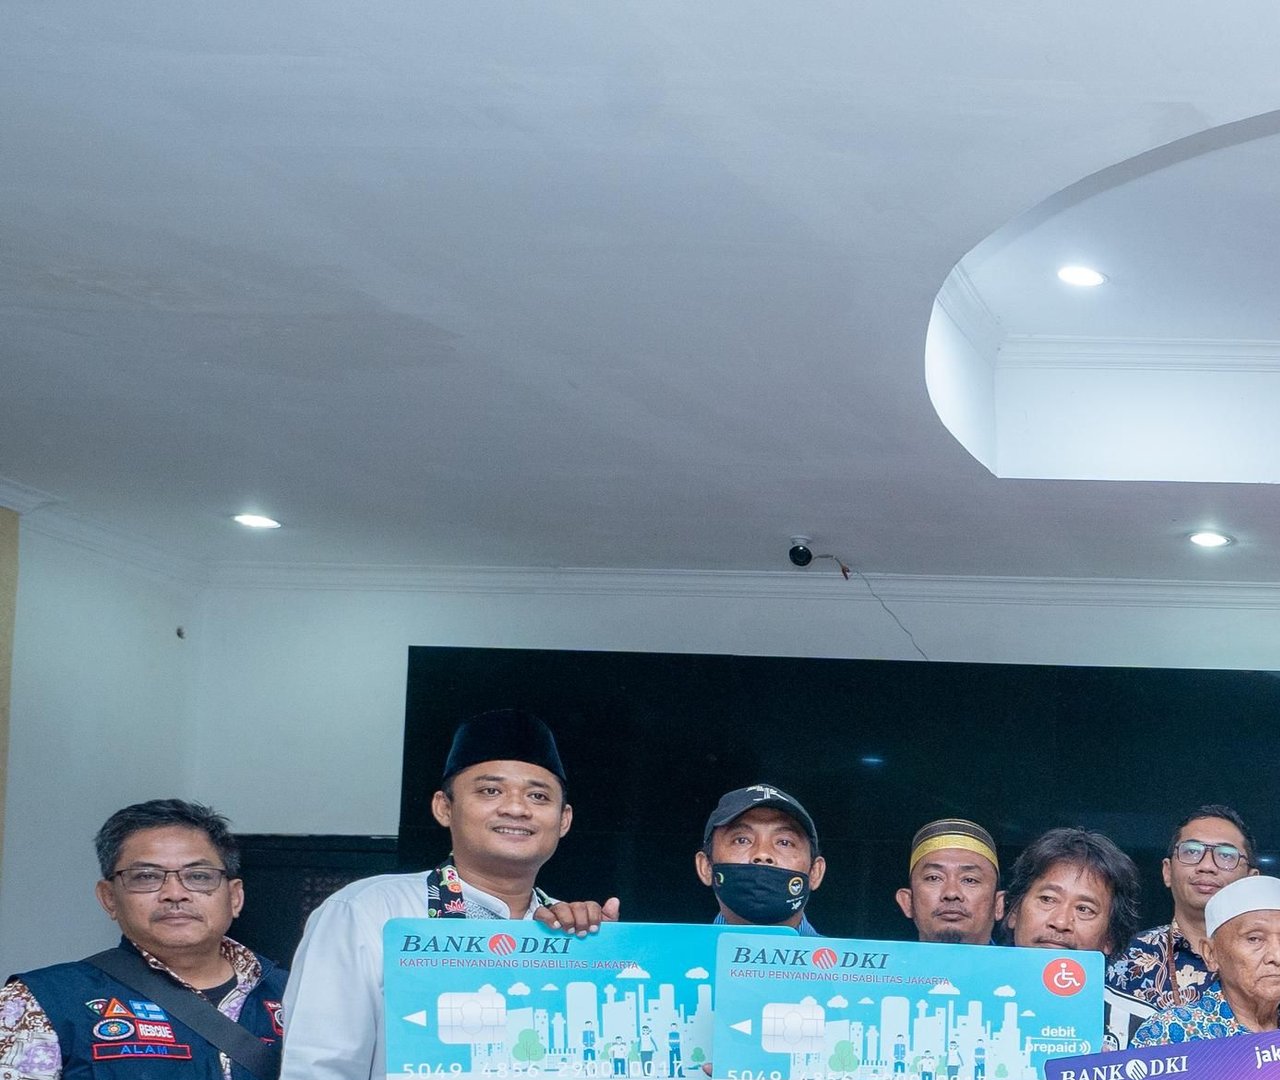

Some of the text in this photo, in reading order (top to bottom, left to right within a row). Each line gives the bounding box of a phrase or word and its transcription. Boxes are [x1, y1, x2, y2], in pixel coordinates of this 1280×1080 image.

[401, 935, 573, 954] BANK DKI
[400, 958, 638, 969] KARTU PENYANDANG DISABILITAS JAKARTA
[732, 947, 890, 970] BANK DKI
[730, 969, 950, 986] KARTU PENYANDANG DISABILITAS JAKARTA
[139, 1023, 173, 1039] RESCUE
[1041, 1026, 1076, 1038] debit
[120, 1045, 168, 1055] ALAM
[1025, 1041, 1077, 1055] prepaid
[402, 1060, 683, 1080] 5049 4856 2900 0017
[1150, 1056, 1188, 1076] DKI
